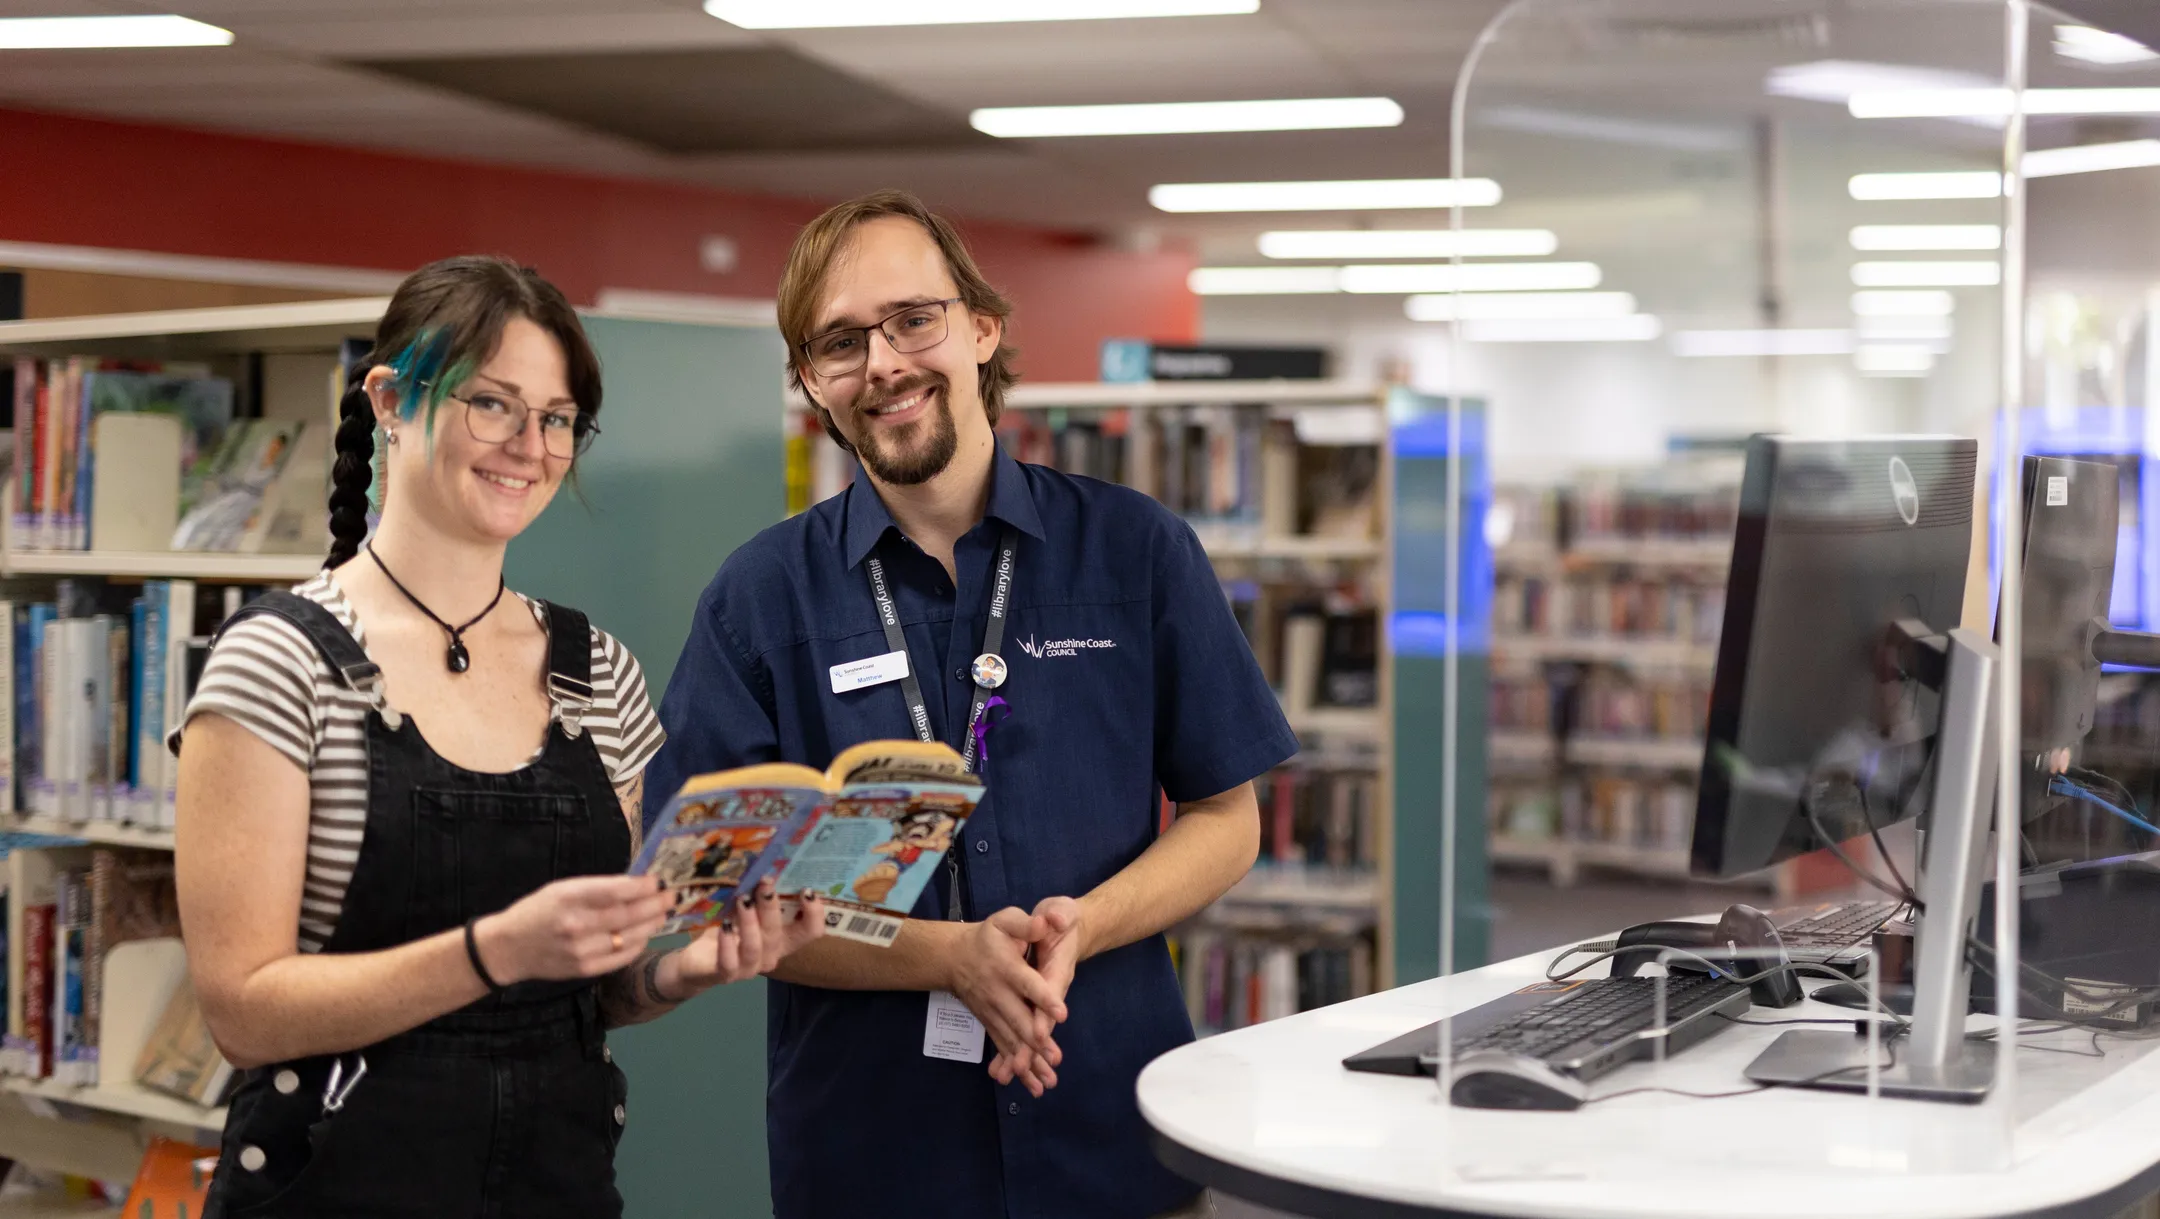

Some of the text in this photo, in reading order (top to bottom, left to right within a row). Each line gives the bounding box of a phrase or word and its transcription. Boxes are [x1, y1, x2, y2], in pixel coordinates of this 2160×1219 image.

[868, 558, 896, 626] #librarylove
[991, 549, 1012, 618] #librarylove
[1044, 638, 1113, 650] Sunshine Coast
[1046, 648, 1078, 657] COUNCIL
[857, 674, 883, 683] Matthew
[912, 704, 932, 745] #librar
